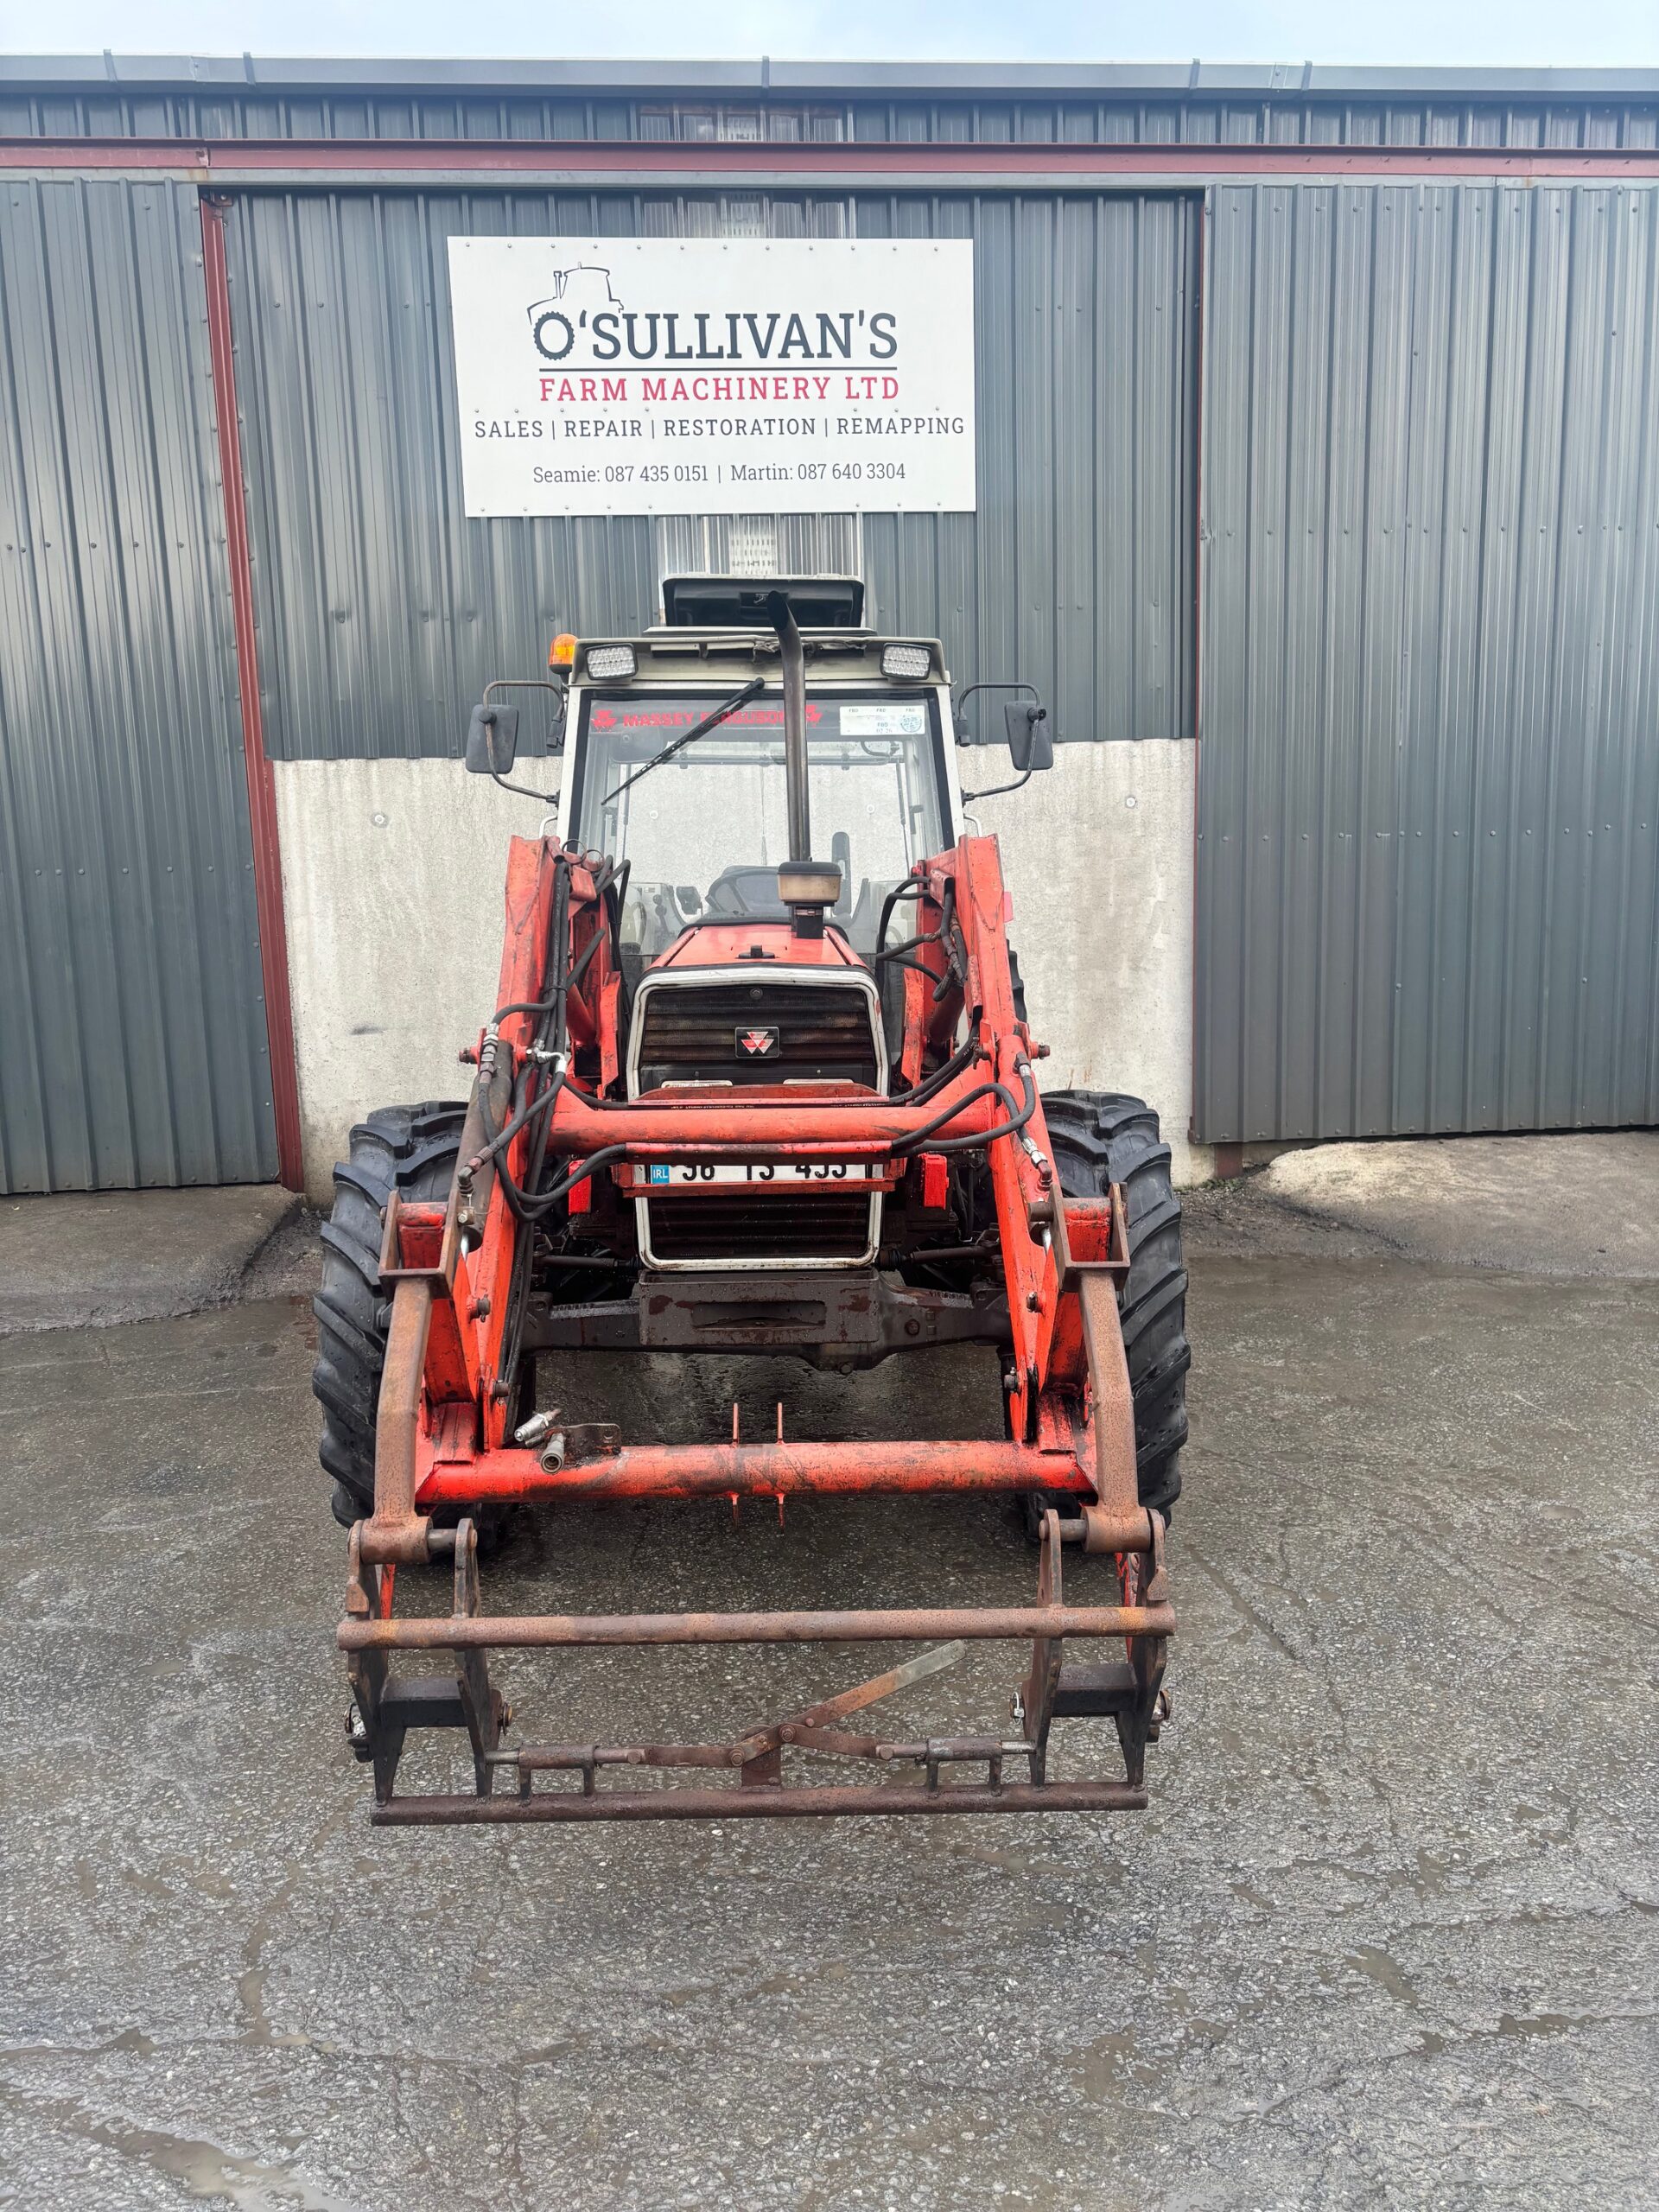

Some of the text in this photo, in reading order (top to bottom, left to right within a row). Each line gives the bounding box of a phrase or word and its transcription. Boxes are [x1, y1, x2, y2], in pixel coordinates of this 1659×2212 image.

[539, 376, 899, 402] FARM MACHINERY LTD
[474, 420, 543, 438] SALES
[563, 419, 643, 437] REPAIR
[663, 417, 816, 436] RESTORATION
[836, 416, 964, 435] REMAPPING
[533, 465, 601, 484] Seamie:
[605, 465, 634, 483] 087
[639, 465, 670, 482] 435
[674, 465, 709, 482] 0151
[730, 462, 793, 481] Martin:
[798, 463, 827, 480] 087
[832, 462, 861, 480] 640
[867, 462, 906, 480] 3304
[622, 711, 695, 727] MASSEY
[653, 1169, 668, 1179] IRL
